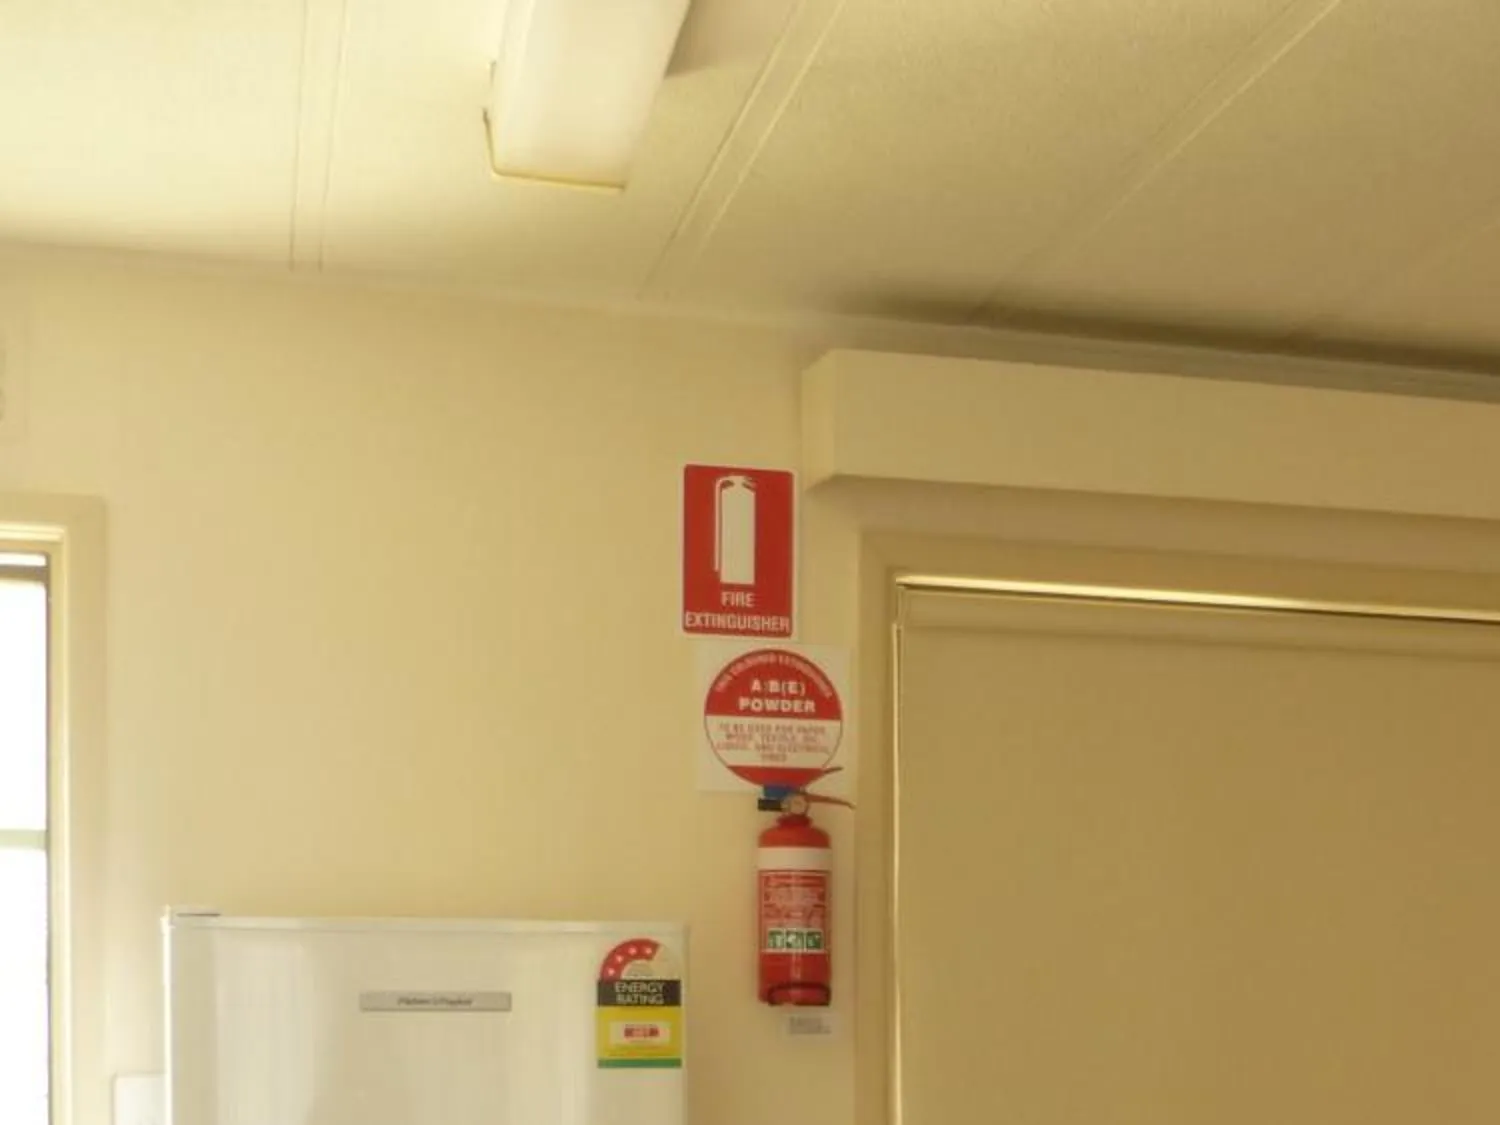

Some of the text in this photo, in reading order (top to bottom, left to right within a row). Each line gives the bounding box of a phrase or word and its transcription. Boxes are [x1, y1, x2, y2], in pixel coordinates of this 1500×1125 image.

[721, 591, 755, 607] FIRE
[685, 611, 790, 633] EXTINGUISHER
[738, 697, 815, 713] POWDER
[615, 981, 665, 993] ENERGY
[615, 993, 665, 1005] RATING
